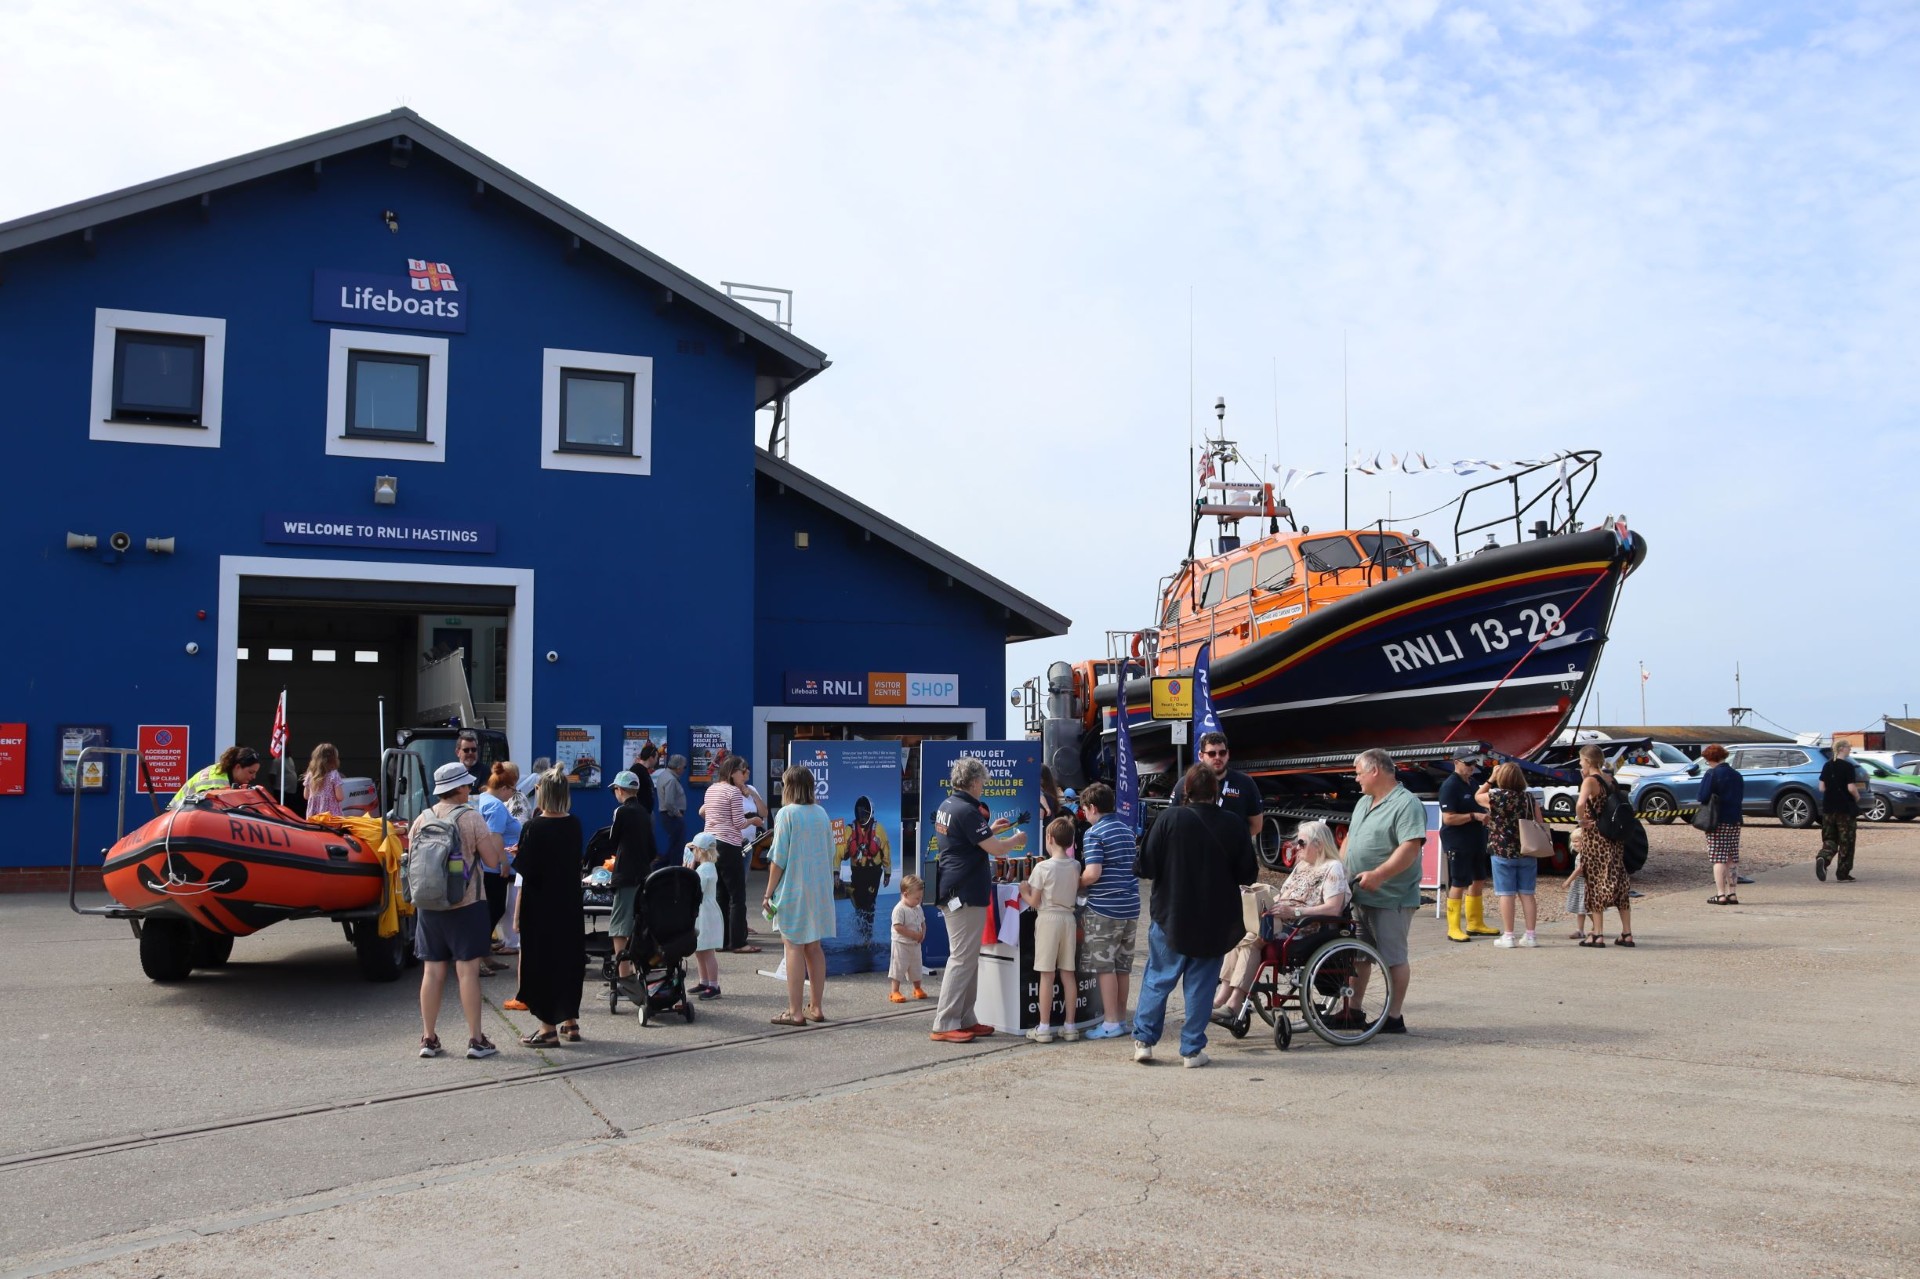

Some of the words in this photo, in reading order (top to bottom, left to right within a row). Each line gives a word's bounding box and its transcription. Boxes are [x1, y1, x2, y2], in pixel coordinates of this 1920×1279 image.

[341, 286, 460, 318] Lifeboats
[284, 521, 353, 536] WELCOME
[356, 525, 374, 538] TO
[377, 526, 409, 539] RNLI
[412, 528, 478, 543] HASTINGS
[1382, 630, 1464, 673] RNLI
[1470, 603, 1566, 653] 13-28
[791, 687, 818, 695] Lifeboats
[823, 681, 862, 695] RNLI
[874, 681, 900, 689] VISITOR
[874, 688, 901, 696] CENTRE
[911, 682, 954, 697] SHOP
[1119, 737, 1129, 792] SHOP
[809, 768, 829, 780] NLI
[989, 769, 1013, 778] ATER,
[983, 779, 1010, 787] COULD
[1012, 779, 1024, 787] BE
[936, 809, 951, 827] RNLI
[228, 819, 292, 848] RNLI
[1028, 982, 1060, 998] Hp
[1079, 978, 1097, 991] save
